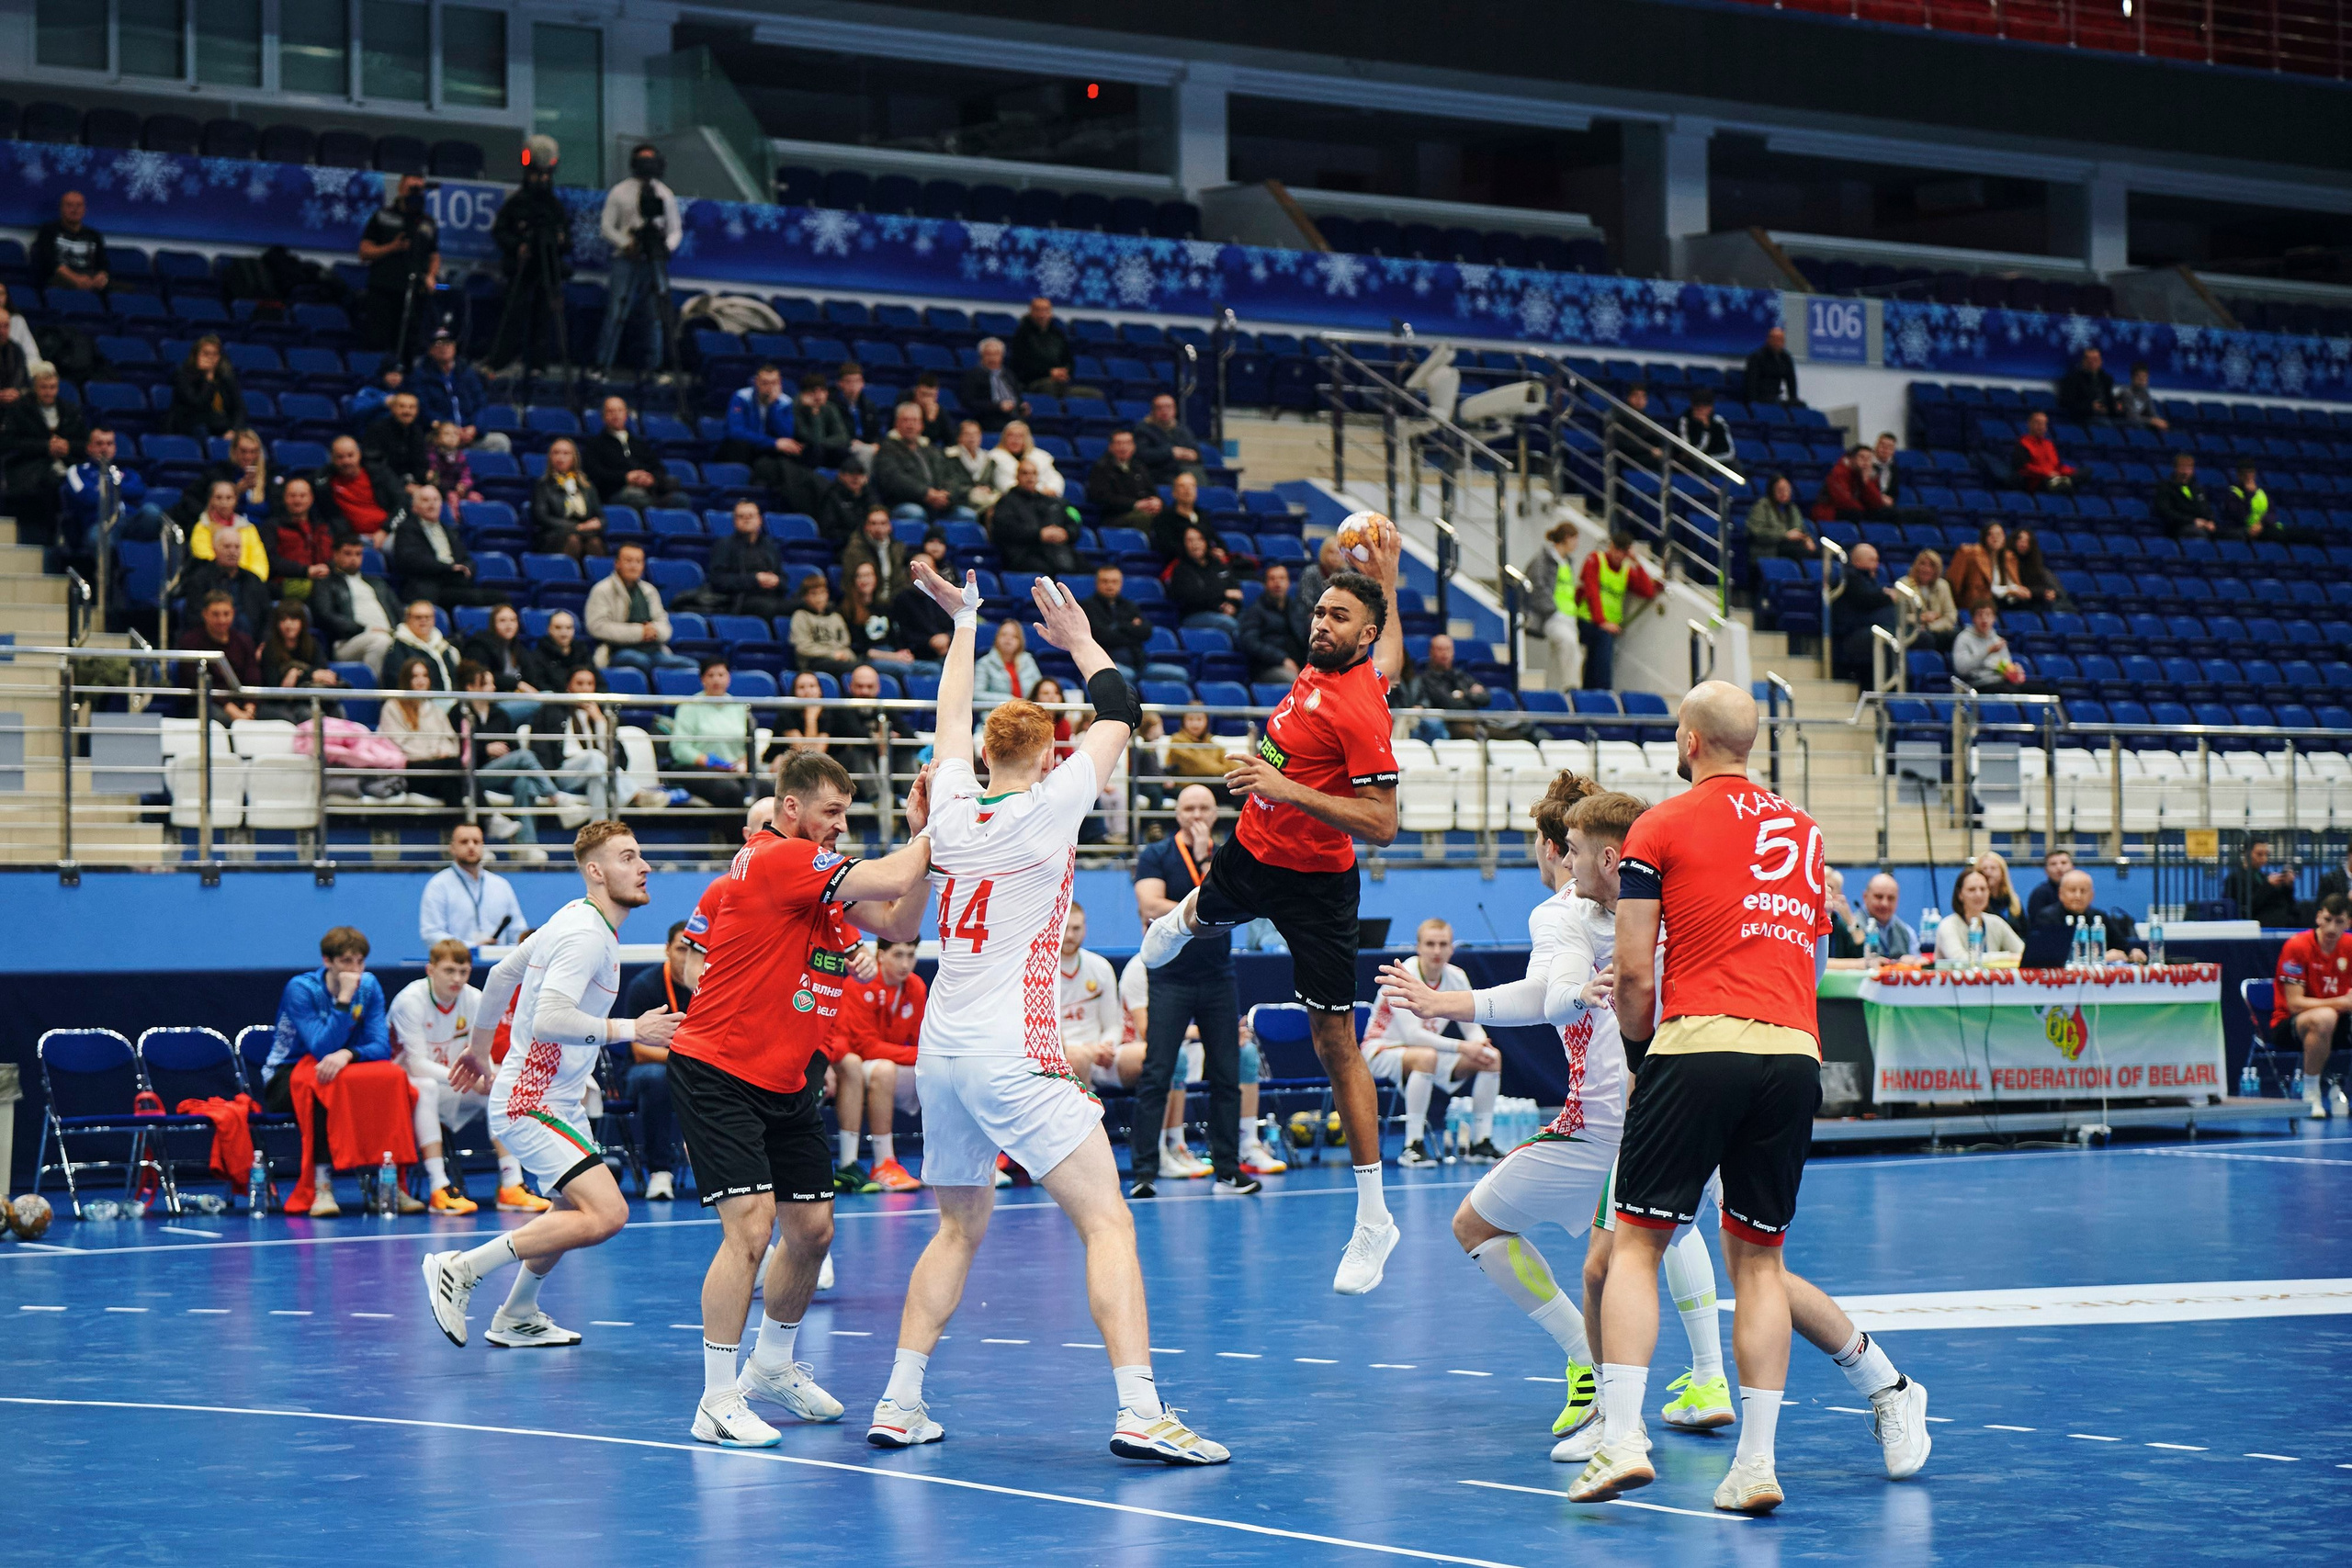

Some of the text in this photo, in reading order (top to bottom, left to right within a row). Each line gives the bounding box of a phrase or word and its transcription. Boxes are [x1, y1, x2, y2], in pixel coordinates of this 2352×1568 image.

[427, 189, 497, 231] 105
[1812, 301, 1862, 340] 106
[1272, 695, 1295, 730] 2
[1351, 773, 1397, 785] Kempa Kempa
[1749, 817, 1824, 896] 50
[830, 865, 849, 886] Kempa
[1630, 860, 1655, 875] Kempa
[1306, 998, 1351, 1012] Kempa Kempa
[1881, 1068, 1983, 1091] HANDBALL
[1991, 1066, 2112, 1090] FEDERATION
[2117, 1065, 2143, 1088] OF
[1354, 1166, 1380, 1174] empa
[728, 1186, 751, 1194] Kempa
[793, 1192, 816, 1201] Kempa
[1626, 1203, 1645, 1213] Kempa
[1649, 1207, 1673, 1218] Kempa
[1729, 1208, 1748, 1223] Kempa
[1752, 1219, 1778, 1233] Kempa
